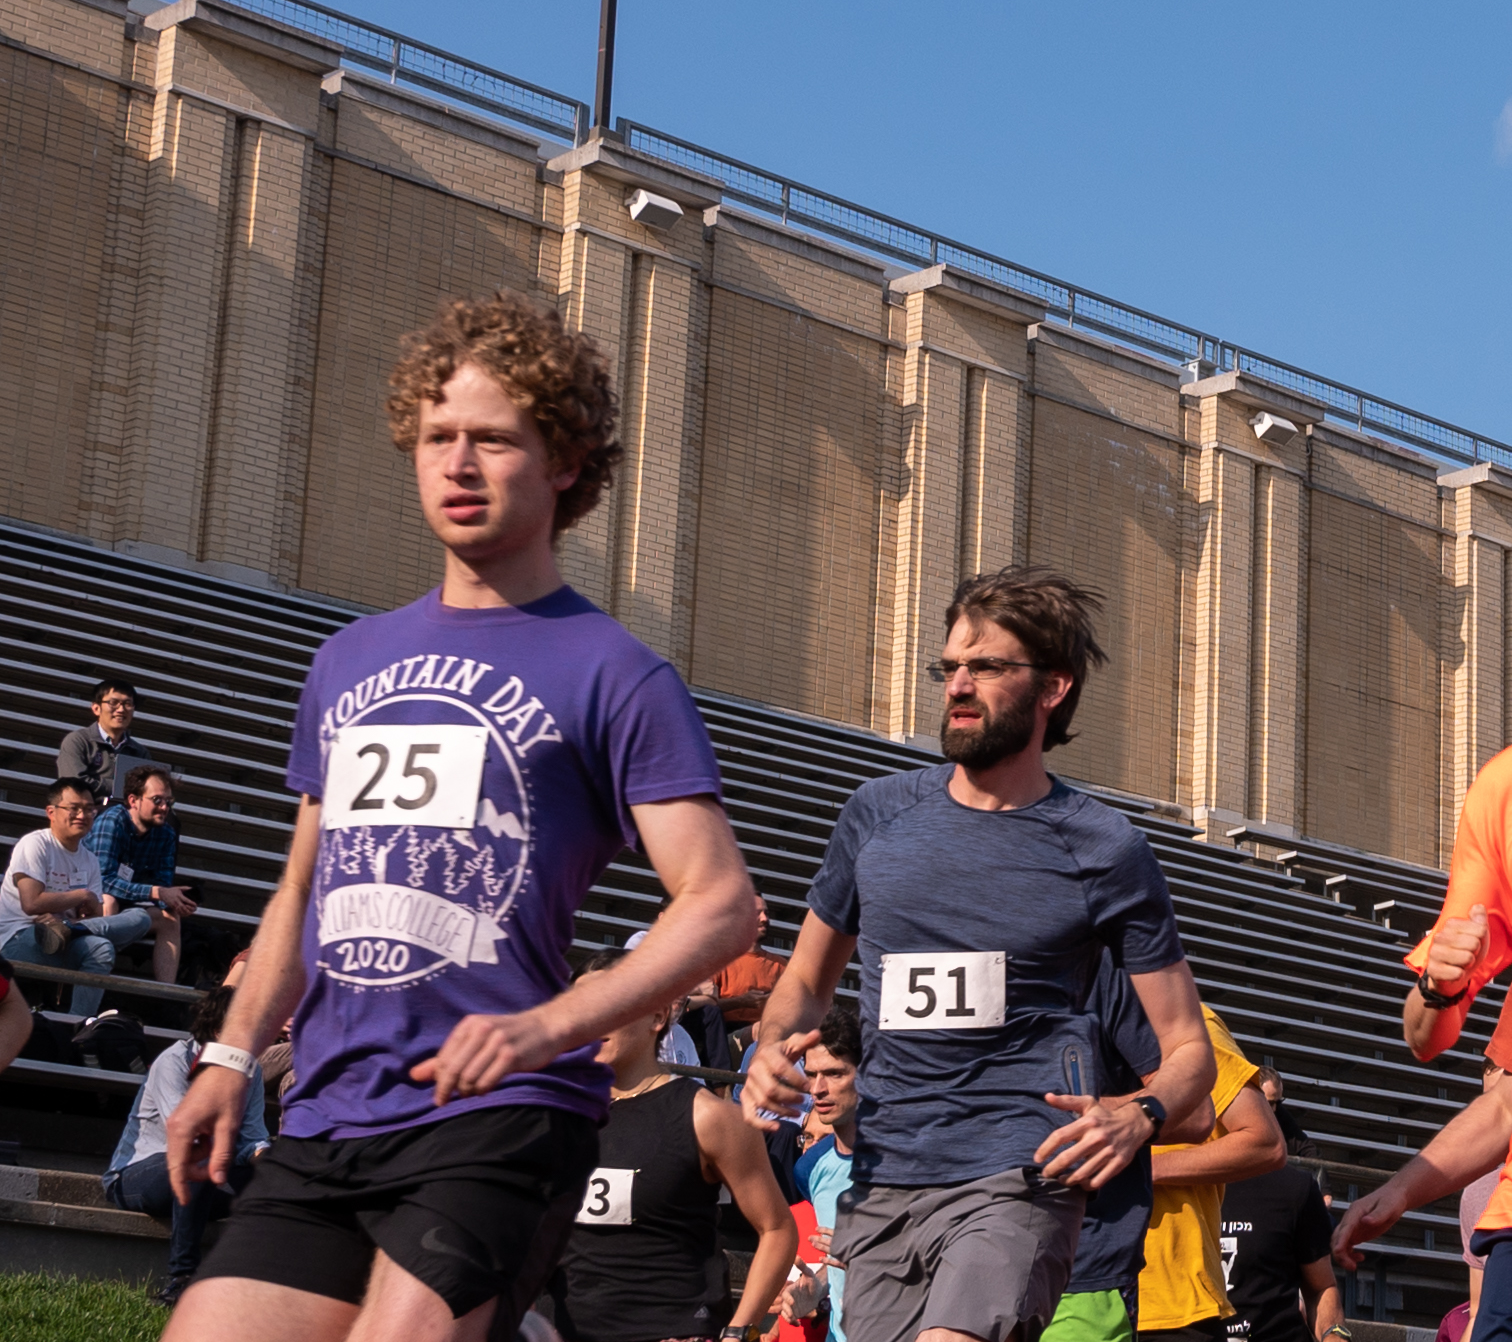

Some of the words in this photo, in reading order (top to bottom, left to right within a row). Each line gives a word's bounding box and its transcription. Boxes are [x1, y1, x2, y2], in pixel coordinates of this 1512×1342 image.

[481, 675, 563, 758] DAY
[349, 742, 442, 811] 25
[387, 891, 470, 953] COLLEGE
[335, 939, 411, 973] 2020
[904, 966, 976, 1019] 51
